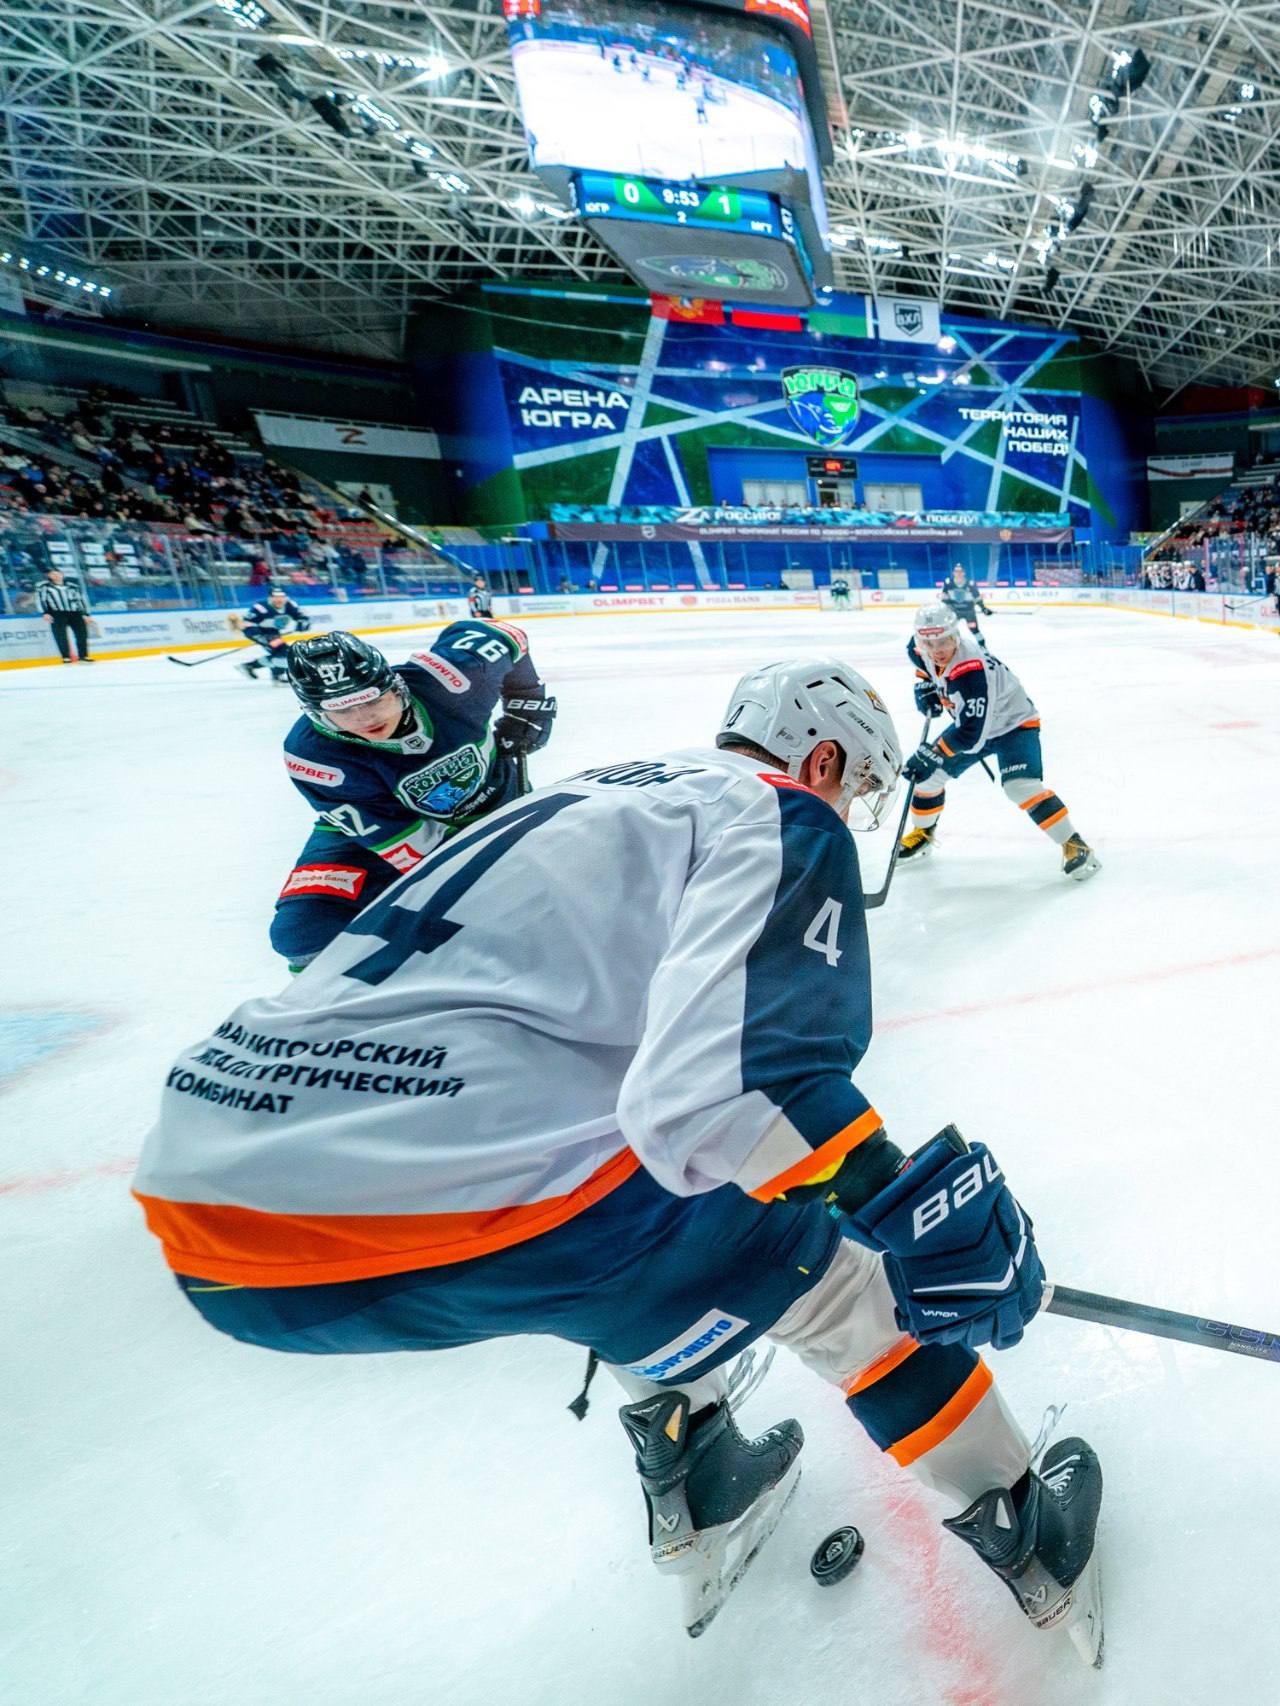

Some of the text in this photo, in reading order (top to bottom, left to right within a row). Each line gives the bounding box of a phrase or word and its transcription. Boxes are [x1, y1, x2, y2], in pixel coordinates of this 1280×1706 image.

[624, 183, 640, 204] 0
[662, 188, 700, 207] 9:53
[718, 194, 731, 215] 1
[518, 387, 630, 410] АРЕНА
[521, 409, 616, 430] ЮГРА
[957, 407, 1068, 427] ТЕРРИТОРИЯ
[1002, 426, 1069, 441] НАШИХ
[1007, 440, 1070, 457] ПОБЕД!
[317, 663, 351, 686] 92
[327, 689, 378, 709] OLIMPBET
[506, 698, 558, 712] BAU
[965, 697, 986, 719] 36
[726, 703, 746, 729] 4
[286, 761, 338, 782] MPBET
[803, 896, 843, 968] 4
[165, 1066, 295, 1114] КОМБИНАТ
[912, 1153, 1003, 1242] BAU
[921, 1308, 960, 1319] VAPOR
